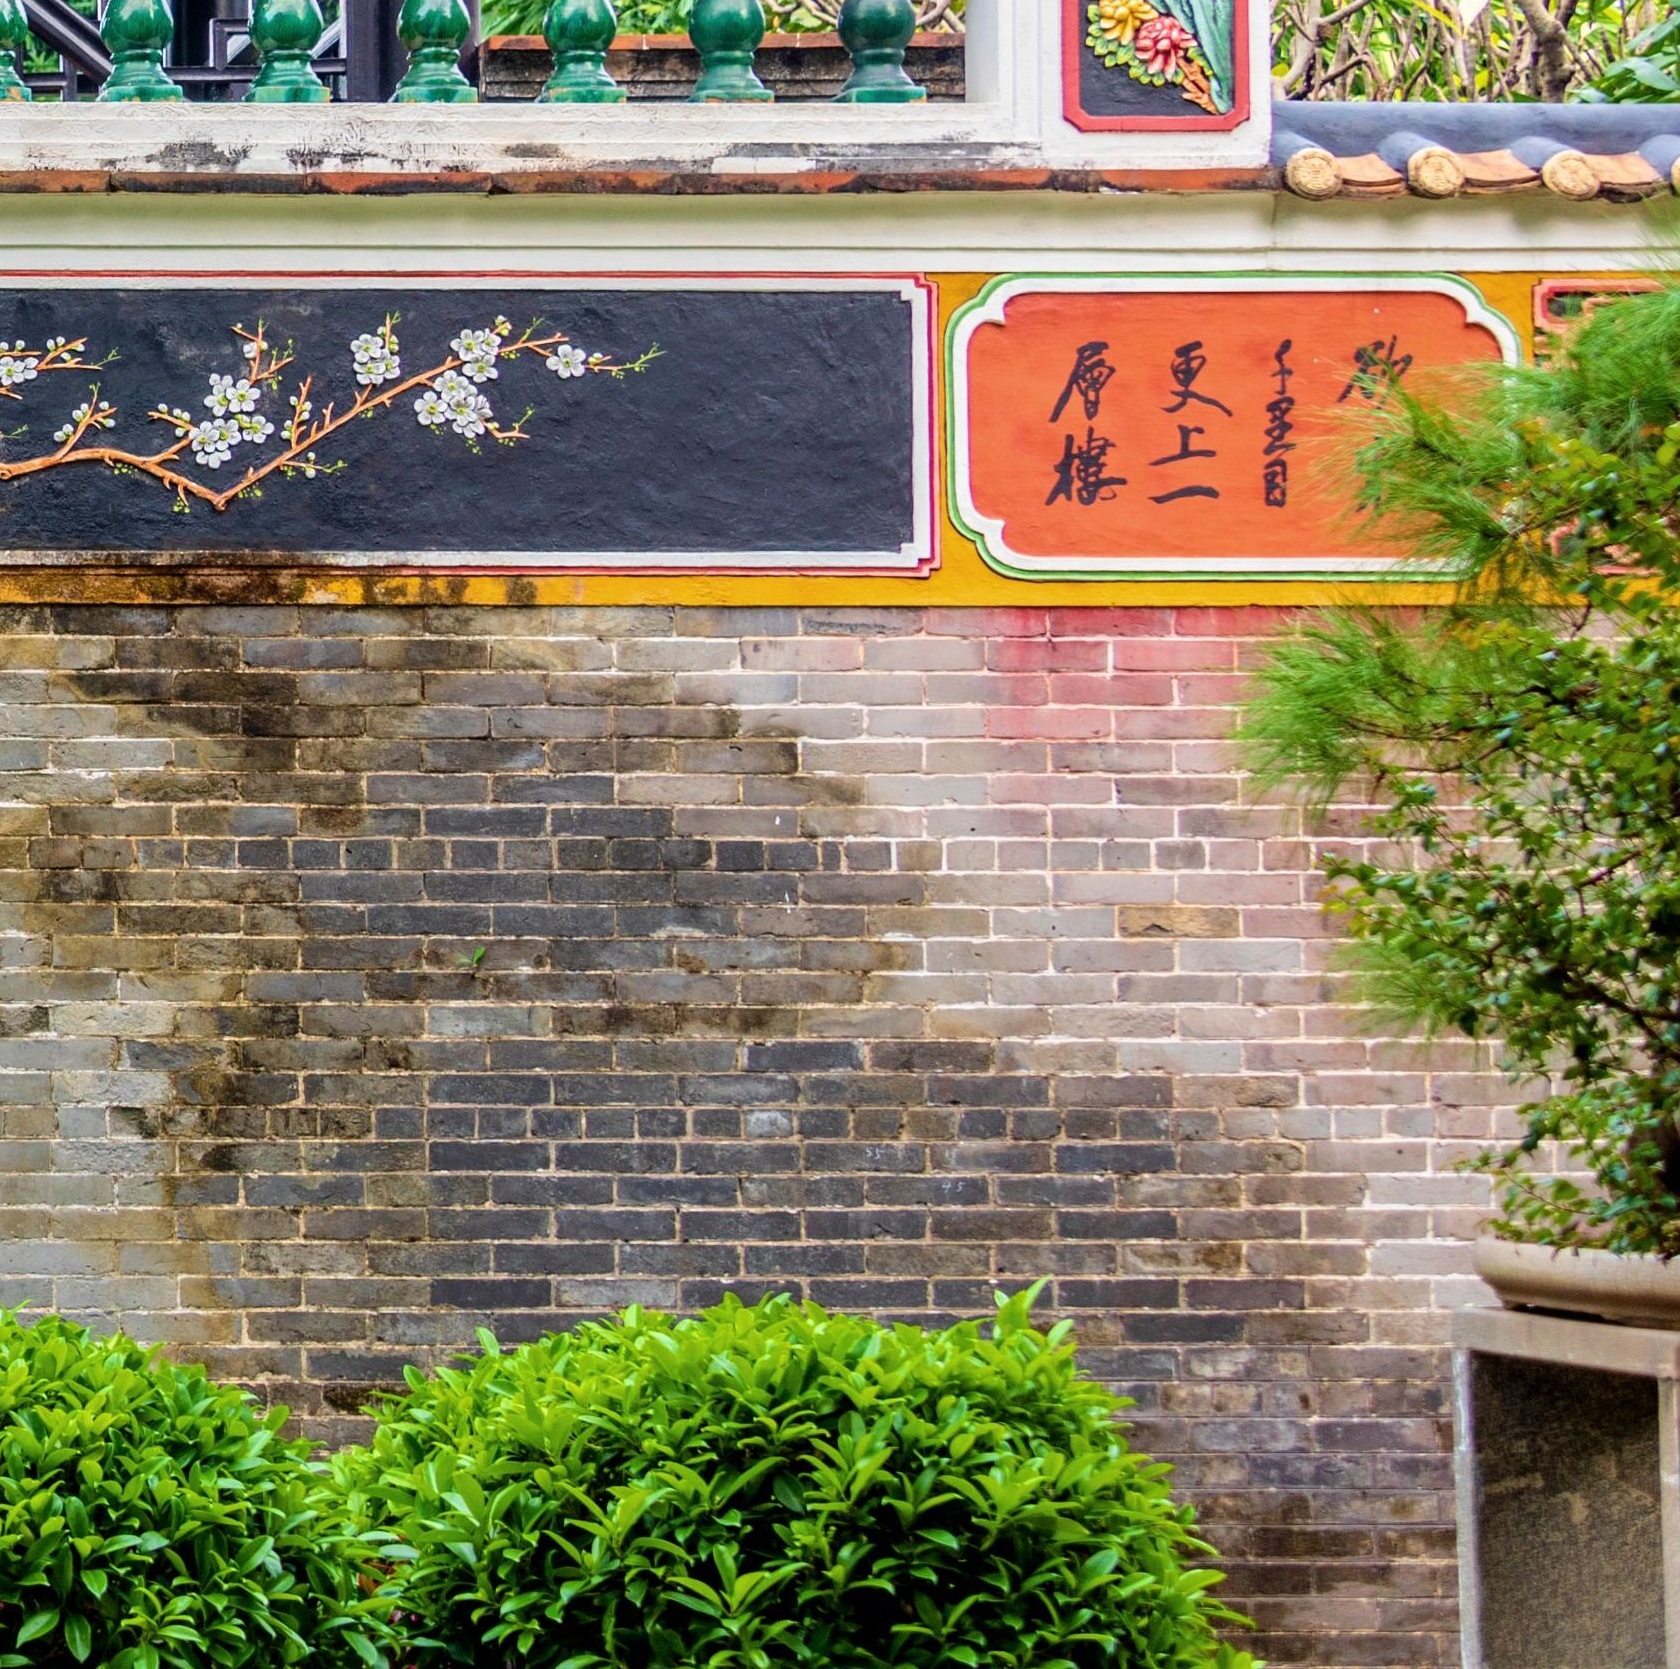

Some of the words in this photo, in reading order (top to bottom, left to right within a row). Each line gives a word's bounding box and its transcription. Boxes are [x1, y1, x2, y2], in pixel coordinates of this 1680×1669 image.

[1149, 340, 1233, 504] 更上一
[1263, 338, 1297, 508] 千里目
